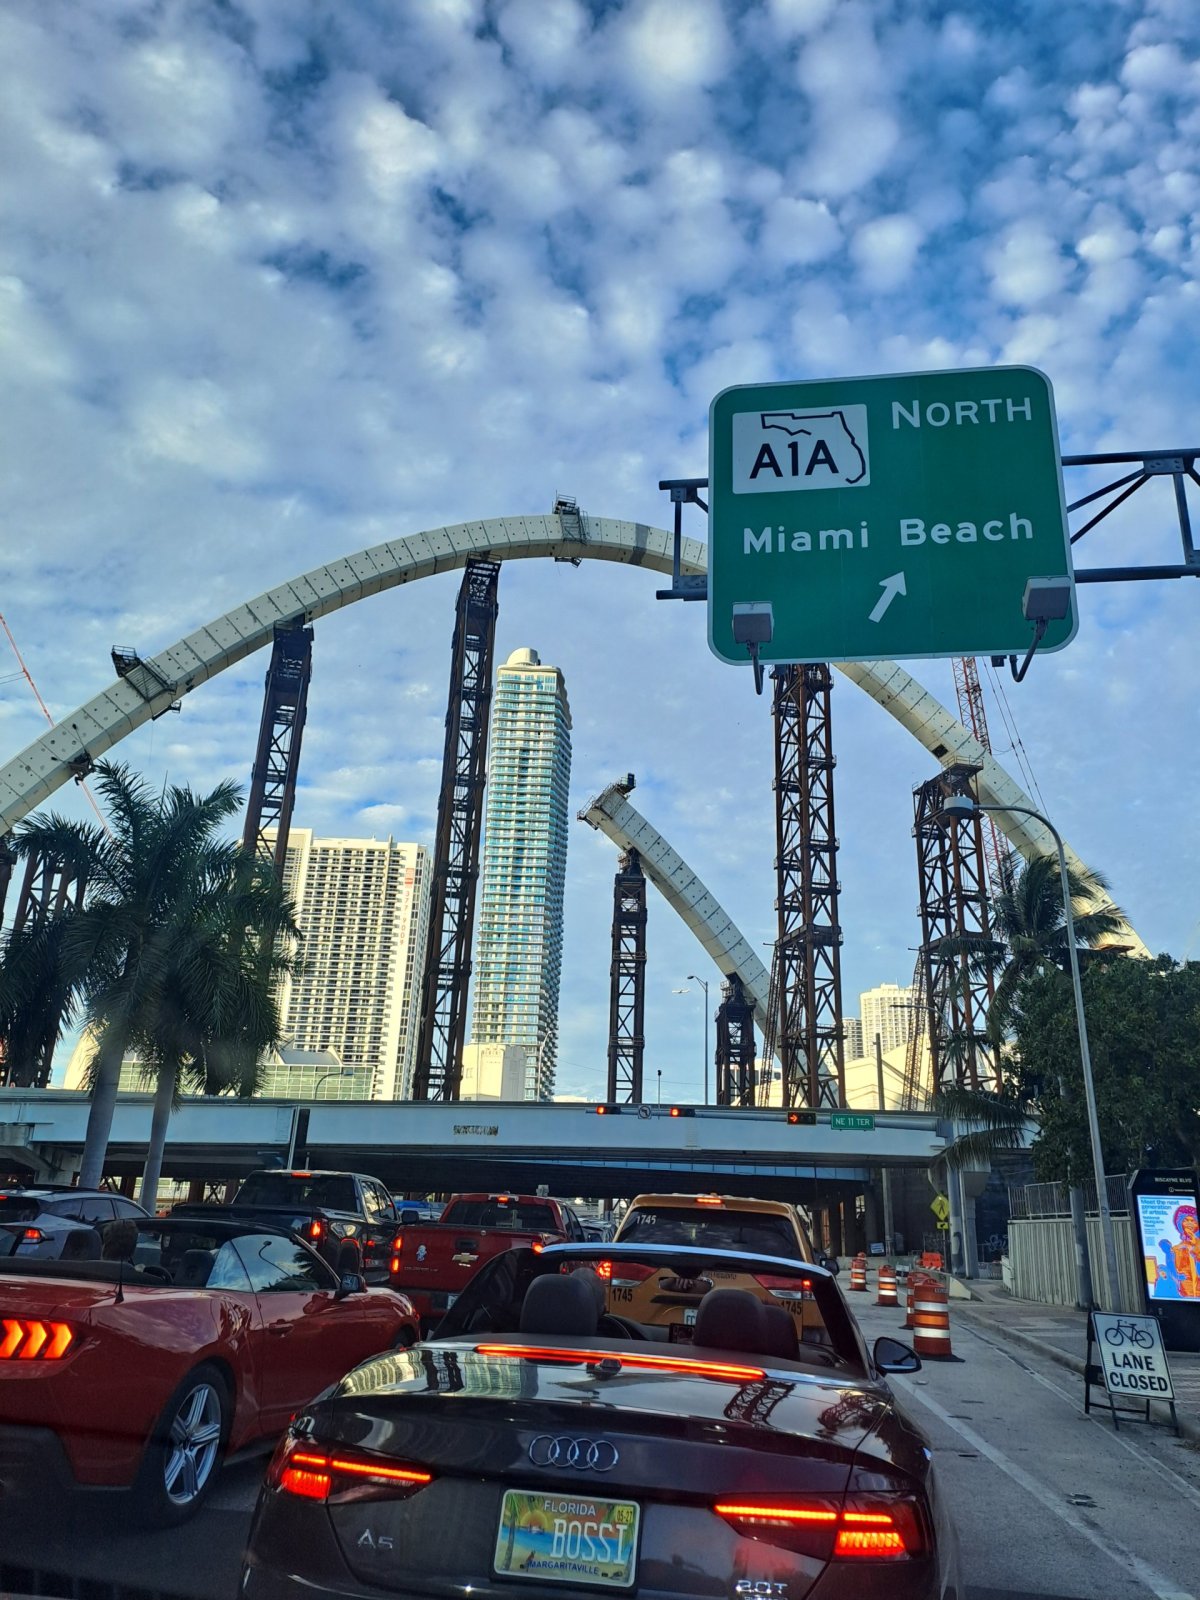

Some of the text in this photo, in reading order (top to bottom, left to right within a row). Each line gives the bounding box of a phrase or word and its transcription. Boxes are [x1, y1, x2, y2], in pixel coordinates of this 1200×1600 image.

[891, 397, 1033, 429] NORTH
[749, 439, 839, 480] A1A
[743, 512, 1034, 554] Miami Beach
[835, 1117, 845, 1126] NE
[848, 1118, 854, 1126] 11
[636, 1215, 657, 1225] 1745
[612, 1288, 633, 1302] 1745
[1111, 1351, 1155, 1371] LANE
[1109, 1371, 1168, 1391] CLOSED
[544, 1500, 596, 1516] FLORIDA
[616, 1510, 633, 1520] 05-27
[357, 1528, 394, 1549] A5
[550, 1518, 628, 1565] BOSSI
[528, 1560, 599, 1575] MARGARITAVILLE
